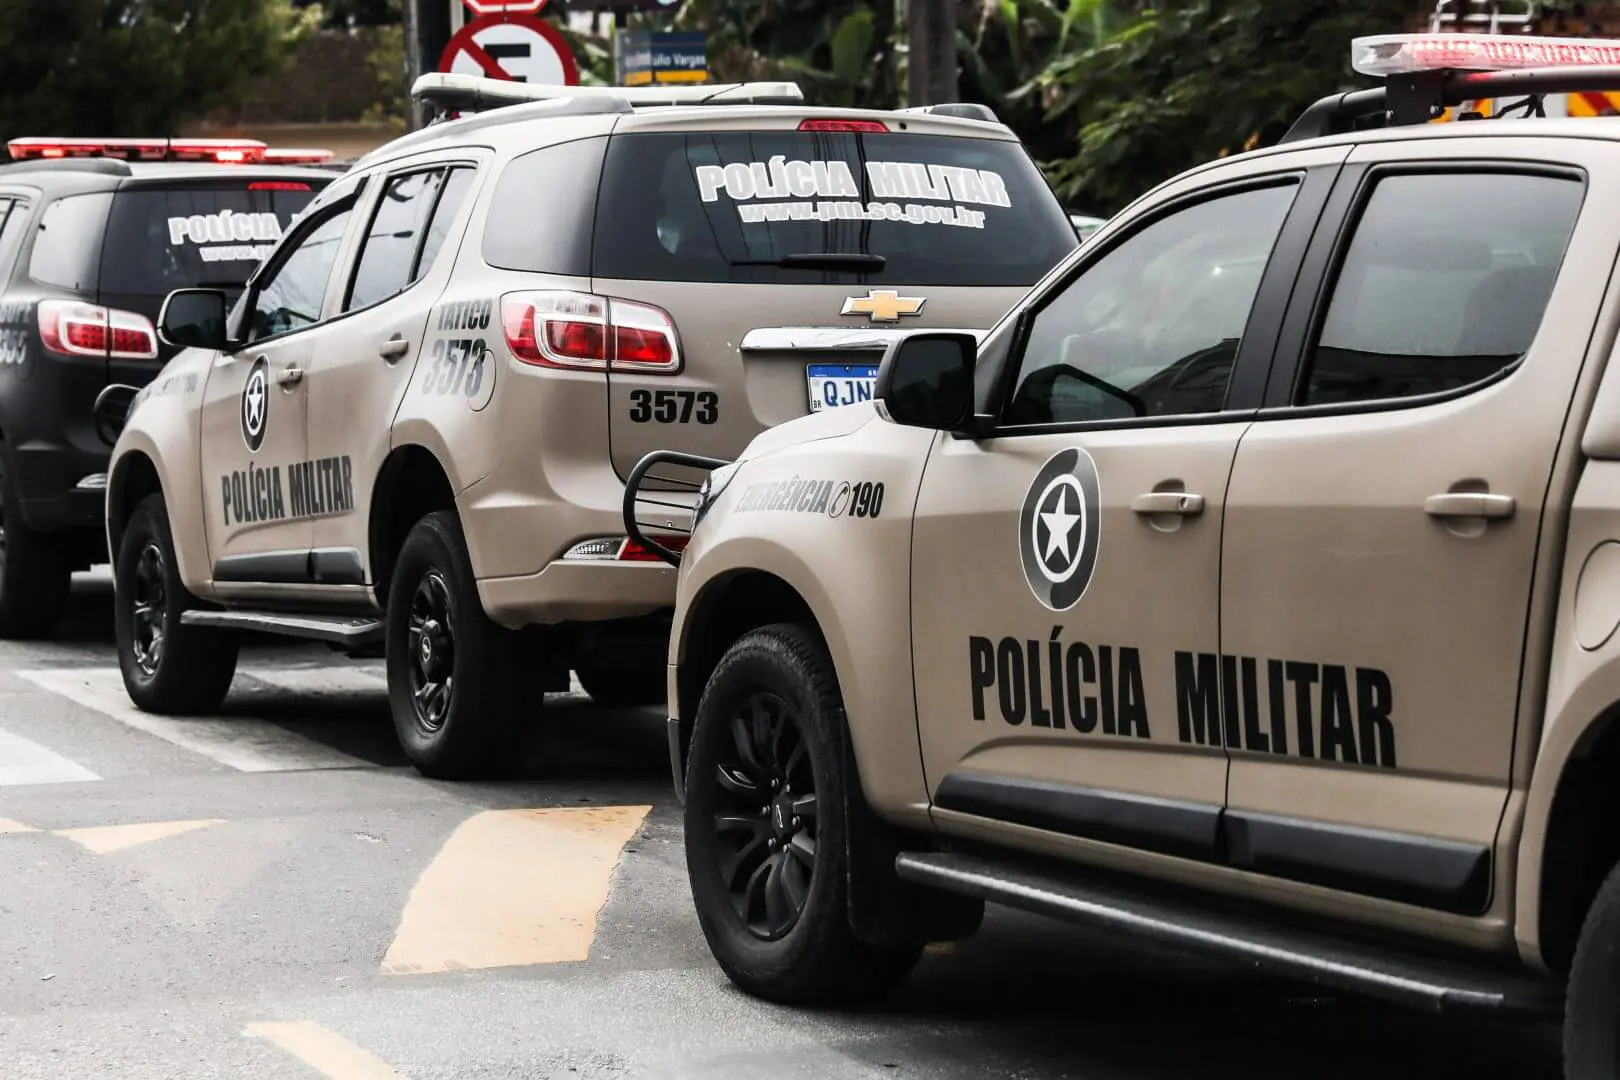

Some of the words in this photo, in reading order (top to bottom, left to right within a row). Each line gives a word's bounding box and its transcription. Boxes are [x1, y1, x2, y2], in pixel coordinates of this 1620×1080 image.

[652, 52, 671, 66] ulio
[673, 52, 706, 68] Vargas
[696, 155, 859, 202] POLÍCIA
[865, 161, 1012, 208] MILITAR
[168, 209, 282, 245] POLÍCIA
[737, 201, 985, 229] www.pm.sc.gov.br
[421, 338, 486, 397] 3573
[629, 389, 719, 425] 3573
[823, 381, 876, 407] QJN
[221, 460, 285, 526] POLÍCIA
[288, 455, 354, 517] MILITAR
[849, 481, 885, 519] 190
[969, 625, 1151, 739] POLÍCIA
[1174, 650, 1397, 769] MILITAR
